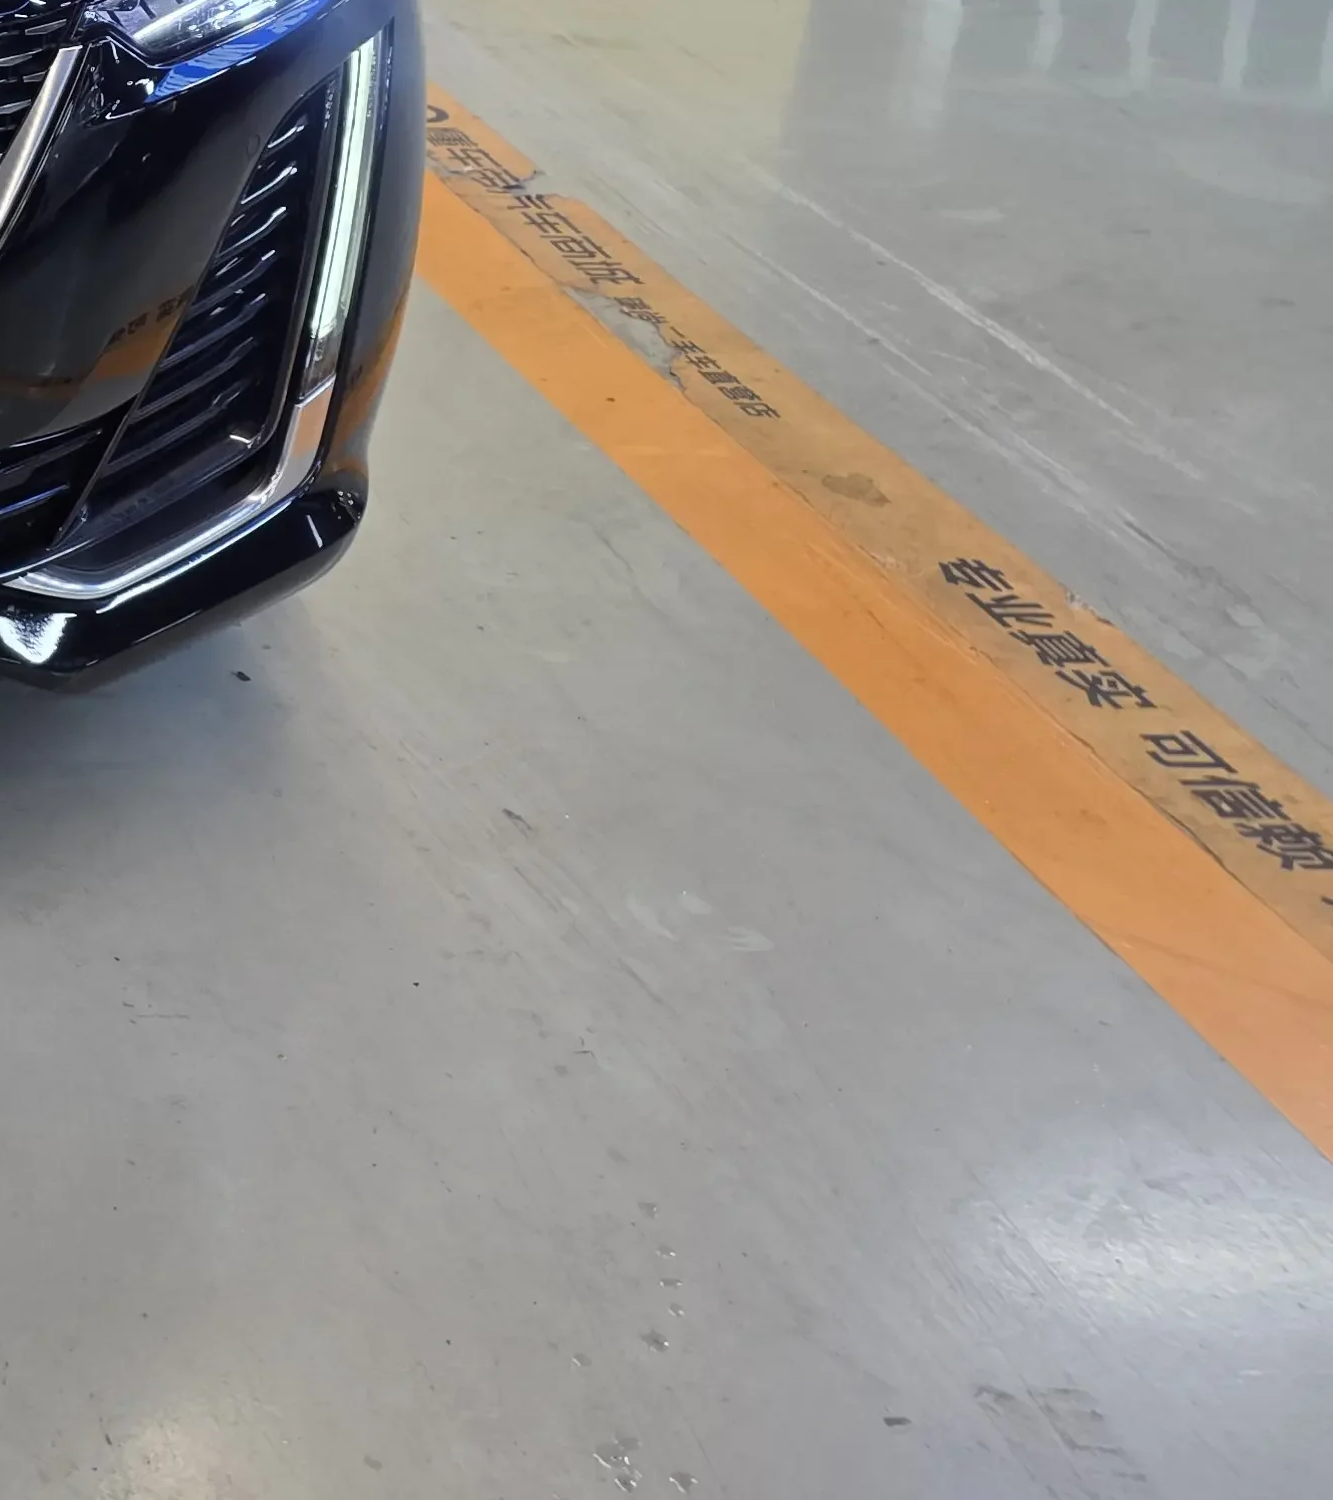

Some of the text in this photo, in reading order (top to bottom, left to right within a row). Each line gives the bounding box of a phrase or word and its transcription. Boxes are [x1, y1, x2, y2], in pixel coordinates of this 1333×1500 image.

[939, 557, 1333, 871] 专业真实 可信赖
